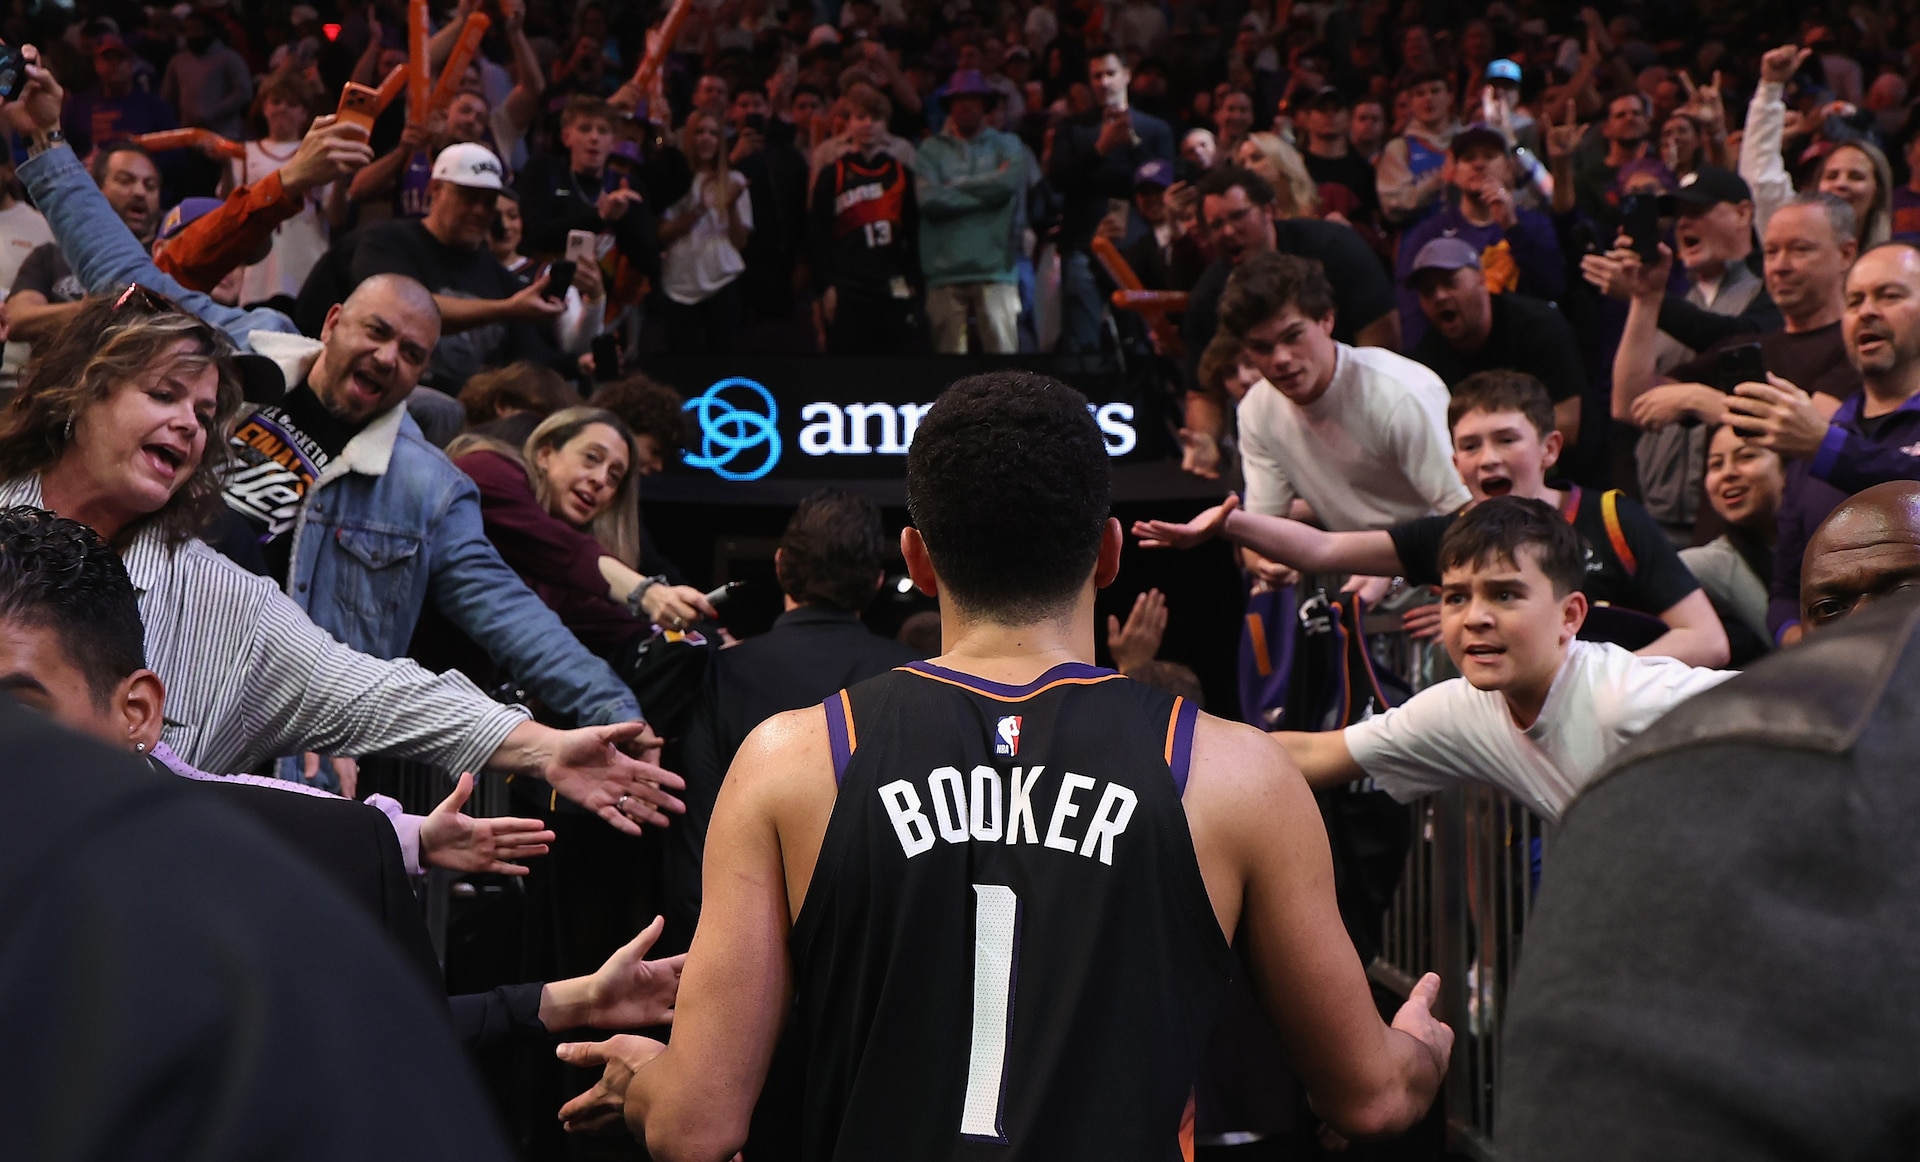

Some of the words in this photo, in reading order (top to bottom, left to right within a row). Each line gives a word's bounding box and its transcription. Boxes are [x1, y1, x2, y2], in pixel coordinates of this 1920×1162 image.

[865, 220, 893, 248] 13
[996, 743, 1010, 754] NBA
[878, 765, 1138, 866] BOOKER
[960, 884, 1020, 1142] 1
